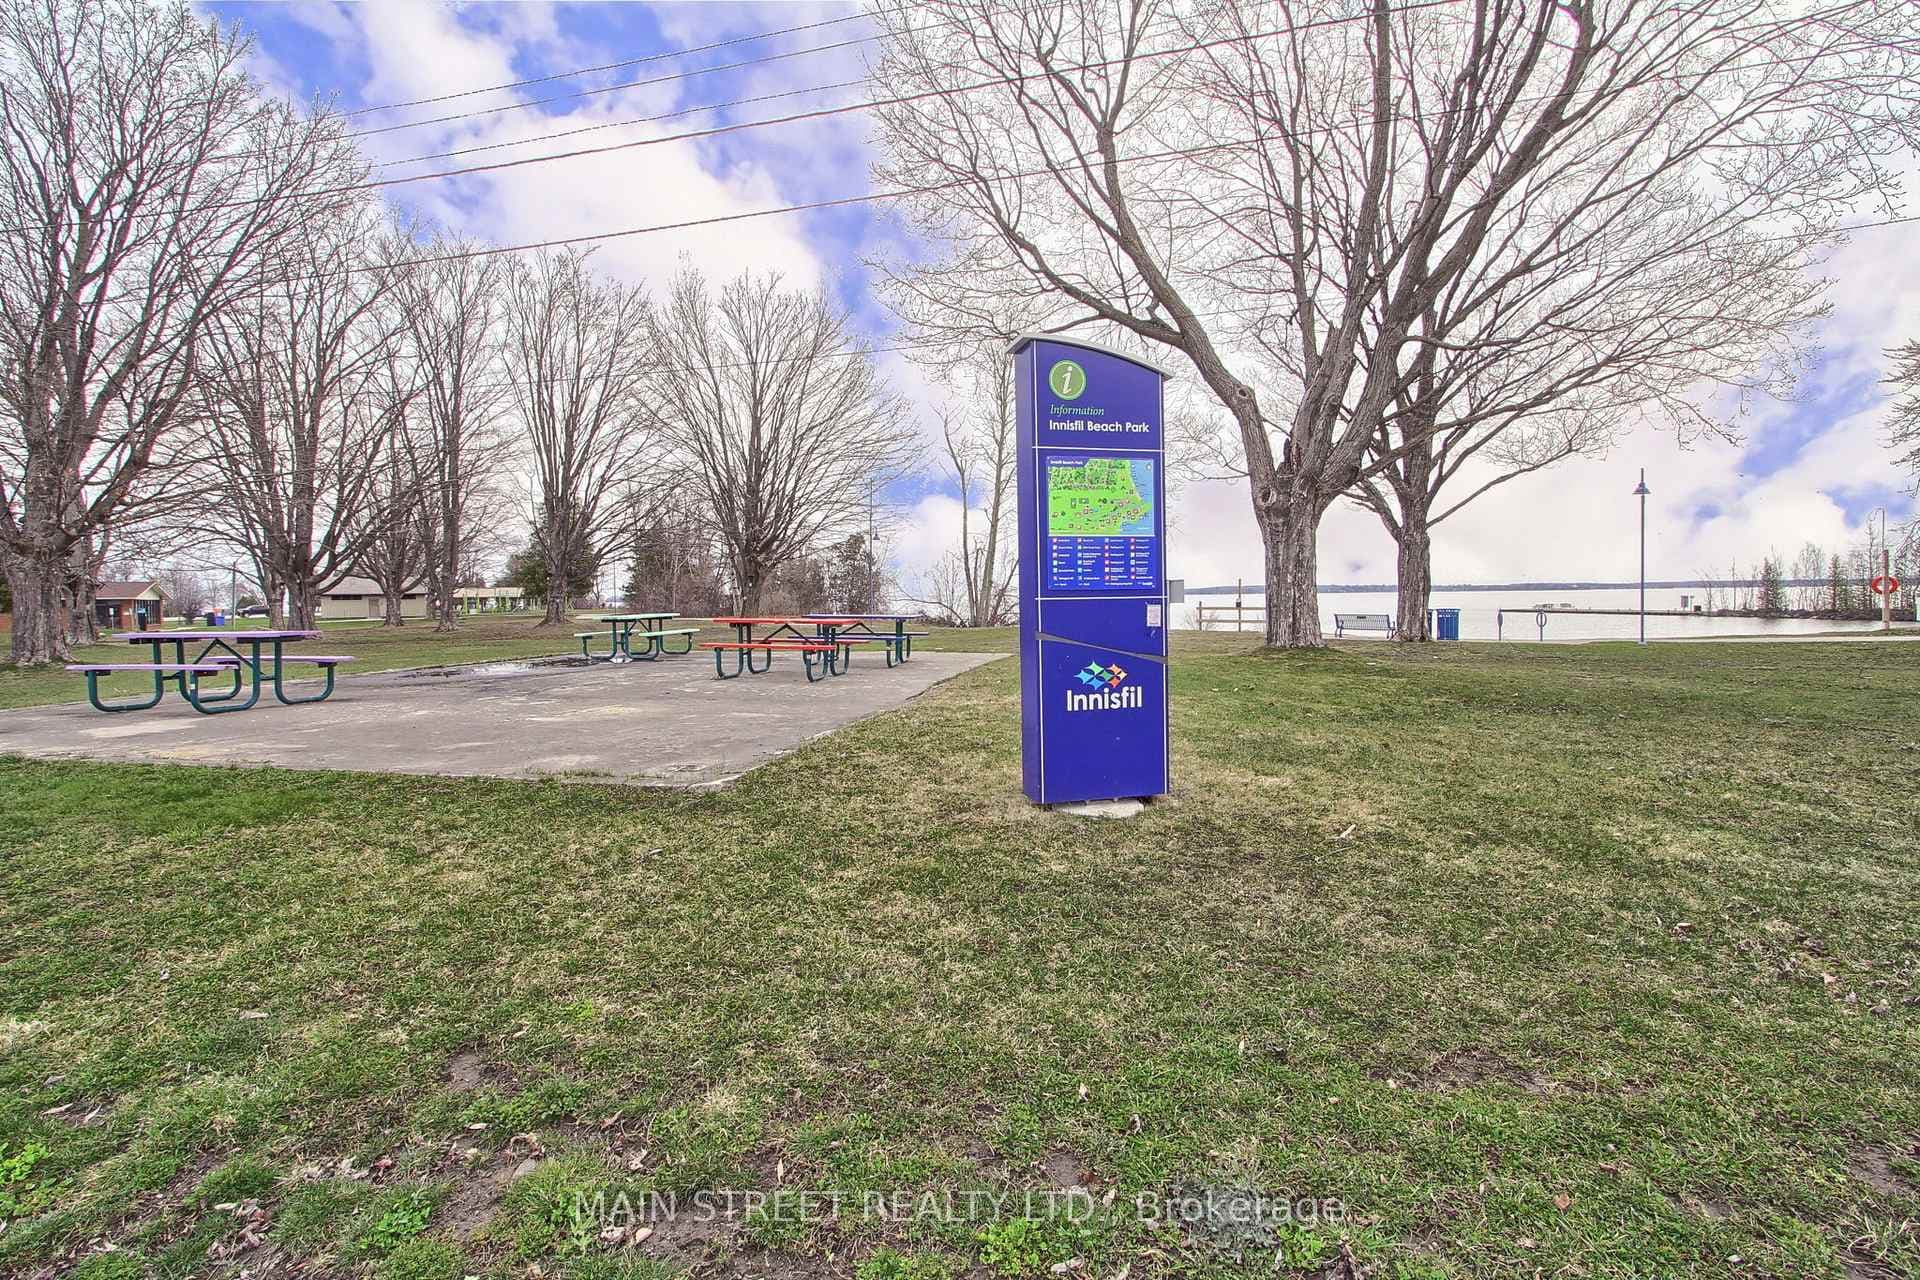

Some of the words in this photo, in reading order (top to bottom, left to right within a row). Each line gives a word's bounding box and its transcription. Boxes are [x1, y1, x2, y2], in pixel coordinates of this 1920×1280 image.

[1050, 404, 1105, 417] Information
[1049, 419, 1084, 431] Innisfil
[1087, 420, 1122, 432] Beach
[1125, 422, 1150, 433] Park
[1066, 686, 1142, 711] Innisfil
